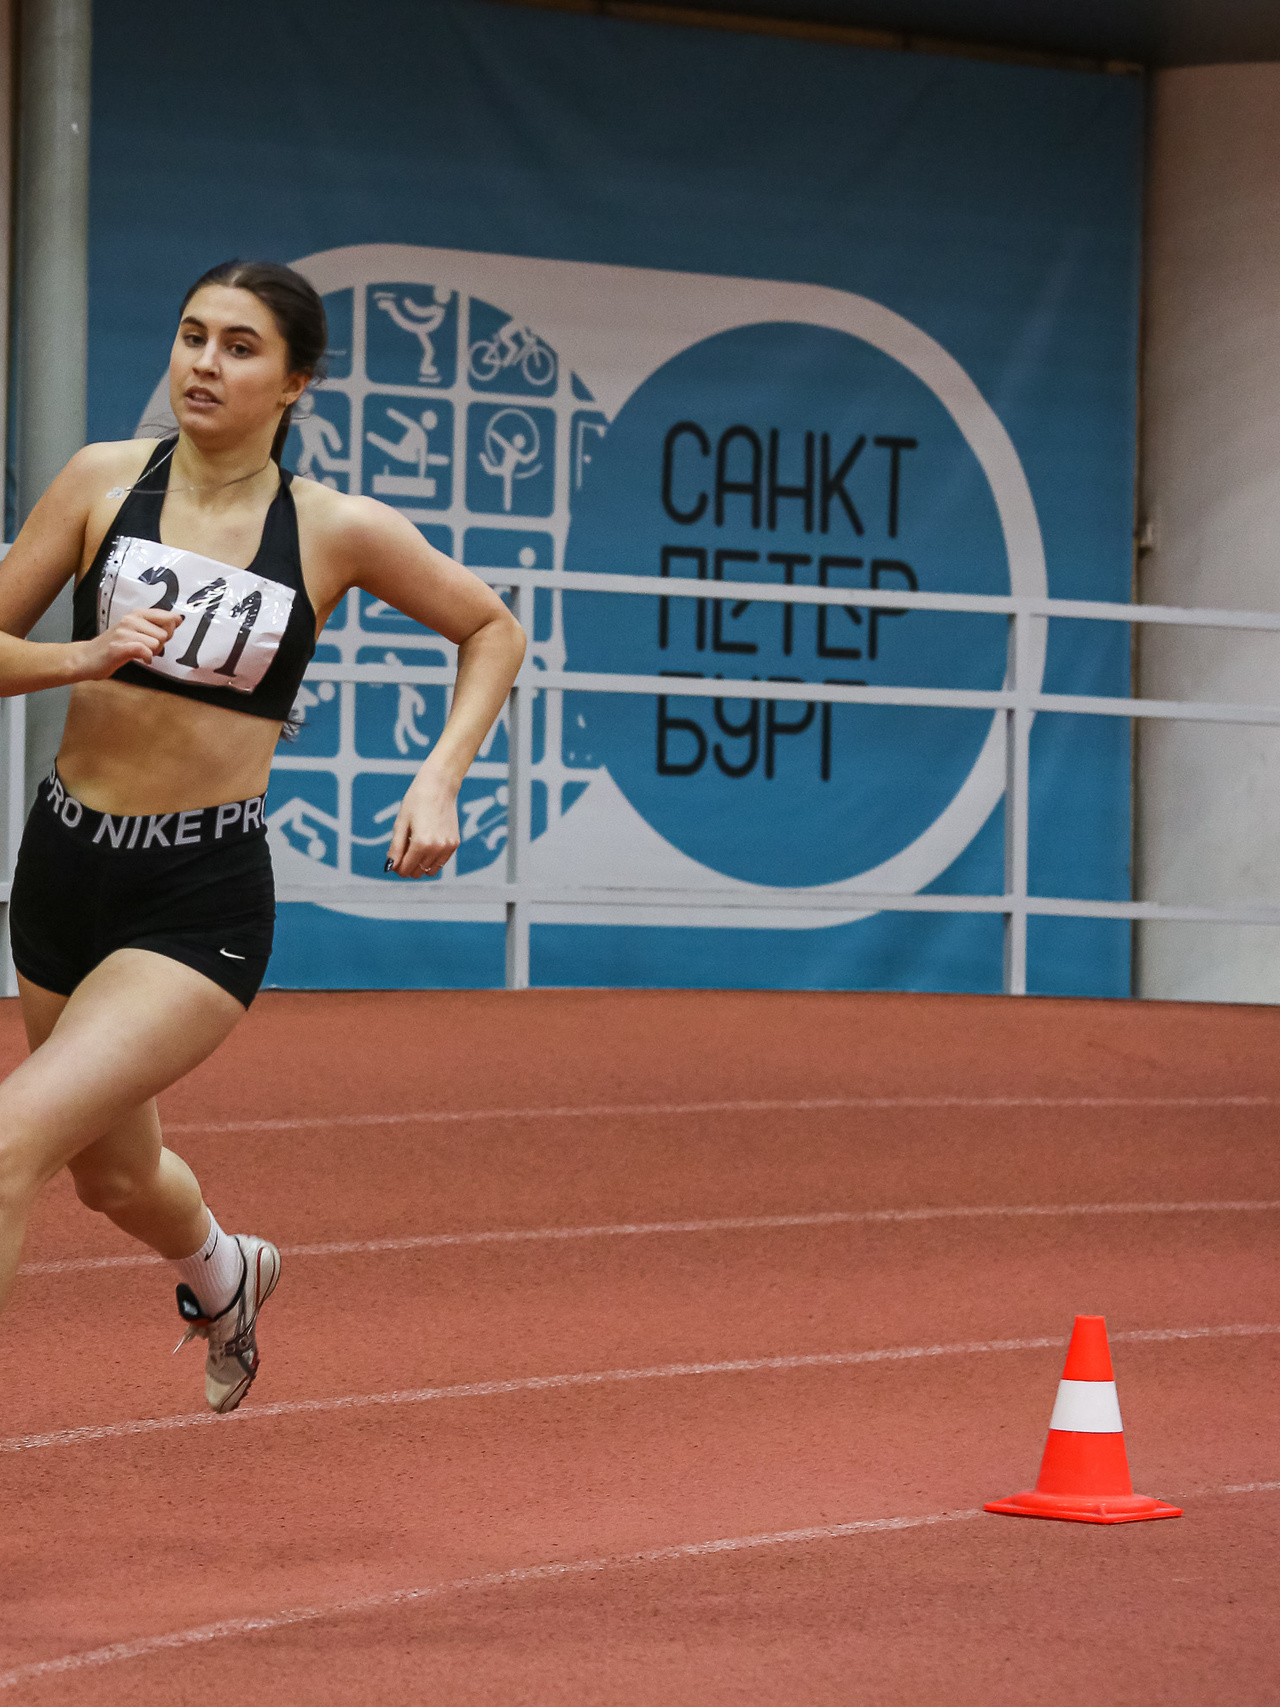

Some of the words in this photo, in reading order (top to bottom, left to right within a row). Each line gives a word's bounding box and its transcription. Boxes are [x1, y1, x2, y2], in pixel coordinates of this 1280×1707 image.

[662, 421, 918, 539] САНКТ
[657, 545, 919, 660] ПЕТЕР
[656, 671, 867, 782] БУРГ
[92, 808, 203, 849] NIKE
[214, 791, 268, 839] PR
